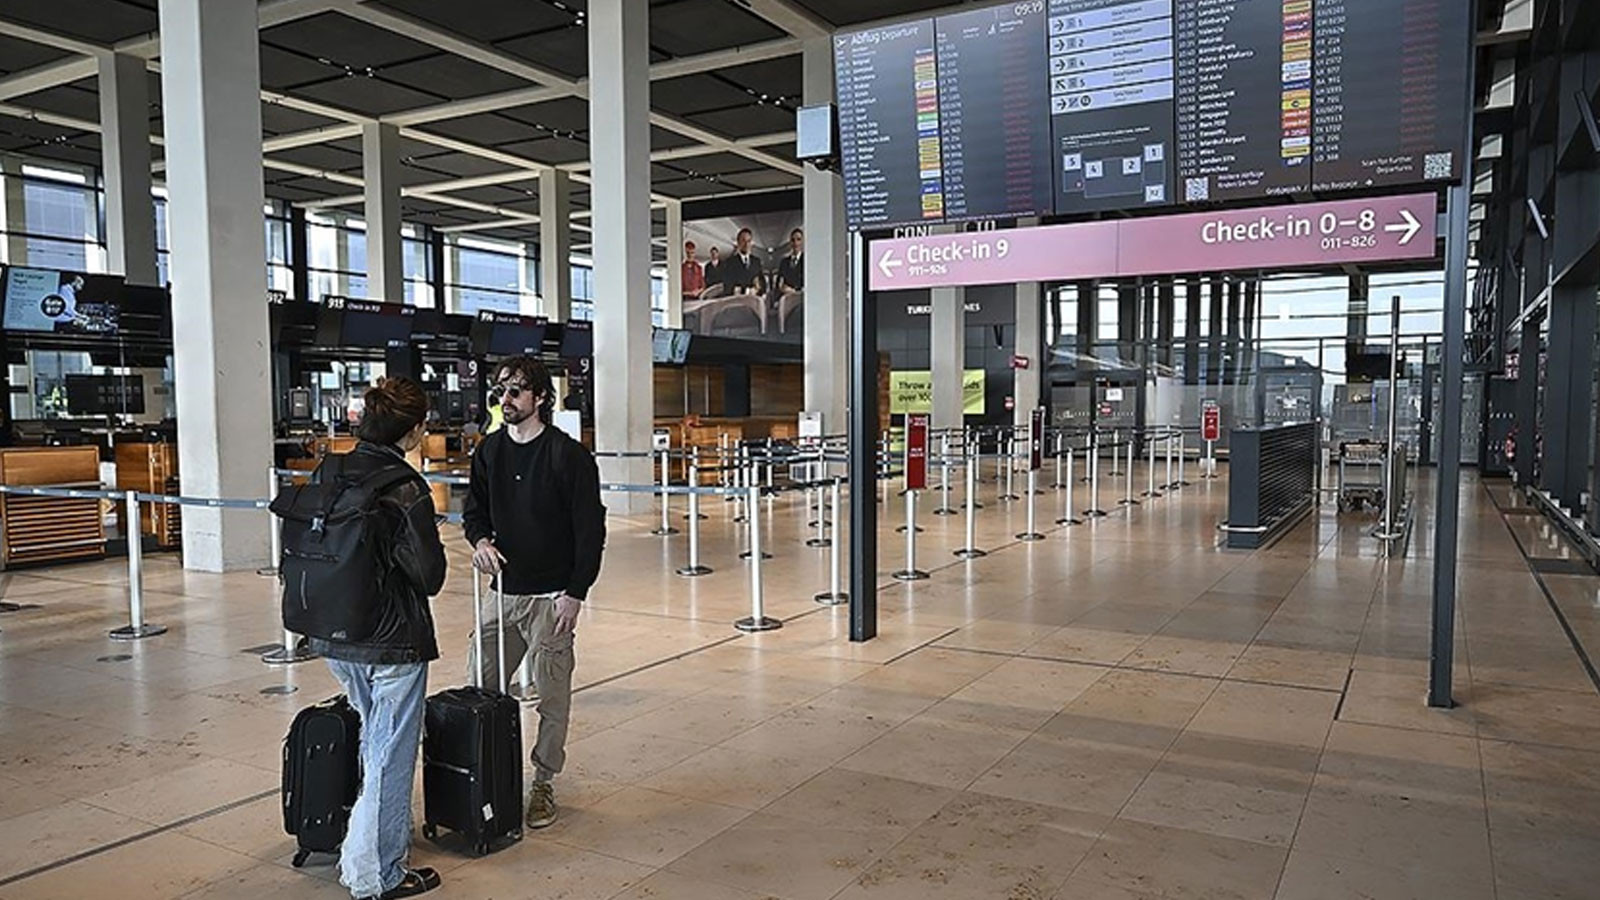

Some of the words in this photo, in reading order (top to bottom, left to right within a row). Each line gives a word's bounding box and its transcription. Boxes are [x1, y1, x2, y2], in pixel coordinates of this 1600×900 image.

[851, 31, 880, 45] Abflug
[881, 27, 919, 40] Departure
[1201, 214, 1310, 243] Check-in
[907, 240, 990, 264] Check-in
[996, 239, 1009, 258] 9
[468, 360, 478, 376] 9
[580, 358, 590, 374] 9
[898, 381, 925, 390] Throw
[898, 394, 917, 402] over
